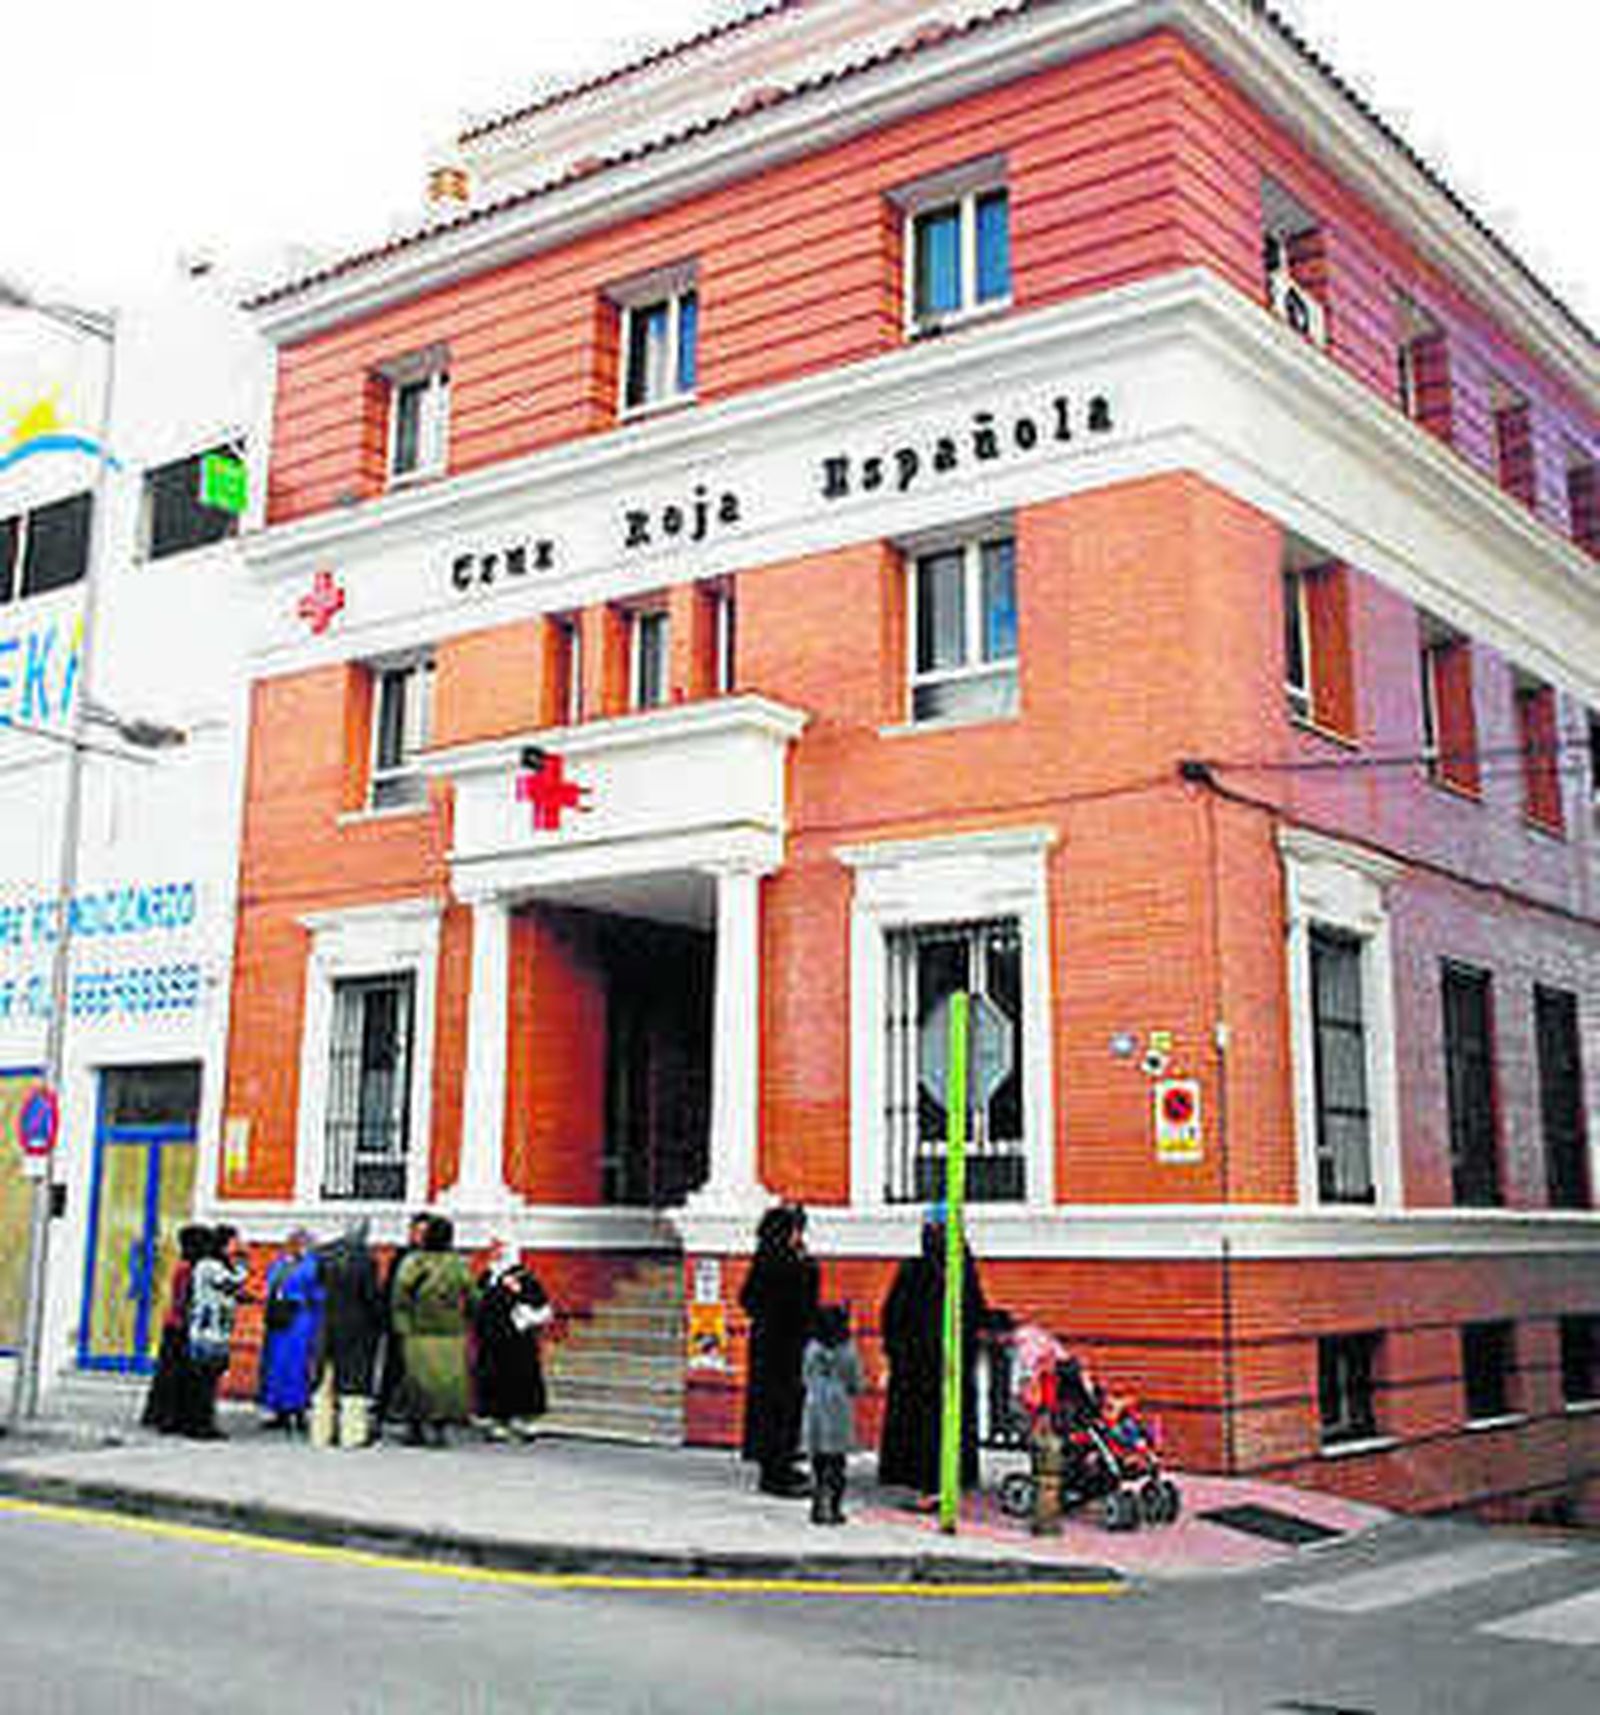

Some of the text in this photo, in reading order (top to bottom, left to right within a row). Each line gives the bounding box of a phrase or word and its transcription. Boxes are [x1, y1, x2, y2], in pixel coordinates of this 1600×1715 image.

[452, 396, 1113, 591] Cruz Roja Española
